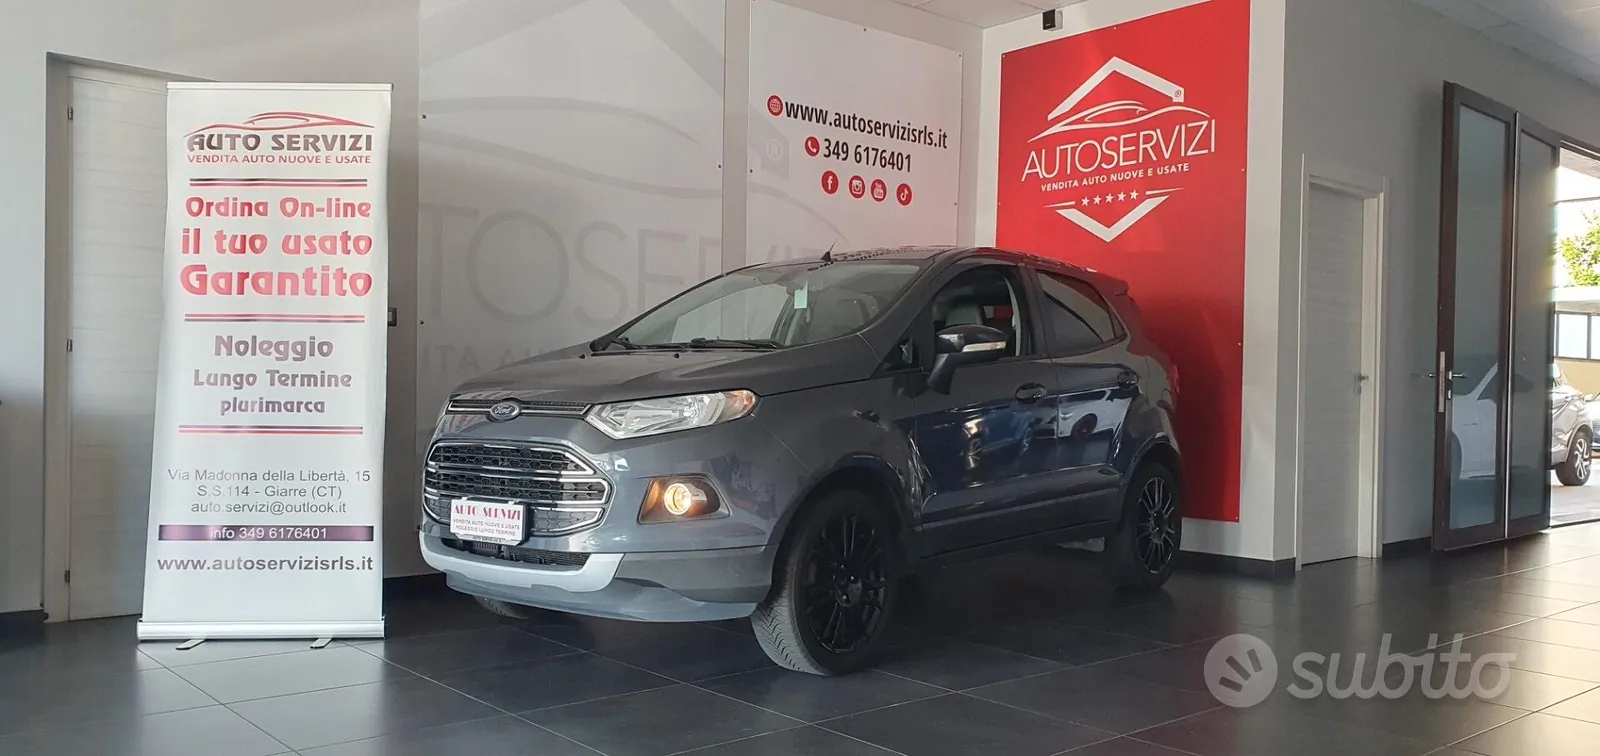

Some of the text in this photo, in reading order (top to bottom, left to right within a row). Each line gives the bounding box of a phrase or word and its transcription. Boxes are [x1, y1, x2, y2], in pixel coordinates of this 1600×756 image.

[785, 101, 948, 149] www.autoservizisrls.it
[186, 133, 373, 153] AUTO SERVIZI
[1021, 119, 1216, 182] AUTOSERVIZI
[187, 154, 371, 165] VENDITA AUTO NUOVE E USATE
[823, 138, 911, 172] 349 6176401
[1041, 163, 1190, 192] VENDITA AUTO NUOVE E USATE
[185, 197, 372, 218] Ordina On-line
[181, 228, 373, 256] il tuo usato
[180, 264, 373, 297] Garantito
[214, 335, 334, 362] Noleggio
[193, 369, 353, 391] Lungo Termine
[220, 397, 326, 416] plurimarca
[167, 469, 371, 484] Via Madonna della Libertà, 15
[196, 485, 250, 497] S.S.114
[264, 485, 307, 498] Giarre
[310, 485, 342, 500] (CT)
[190, 500, 347, 516] auto.servizi@outlook.it
[455, 504, 477, 516] AUTO
[210, 527, 327, 540] info 349 6176401
[157, 556, 373, 571] www.autoservizisrls.it
